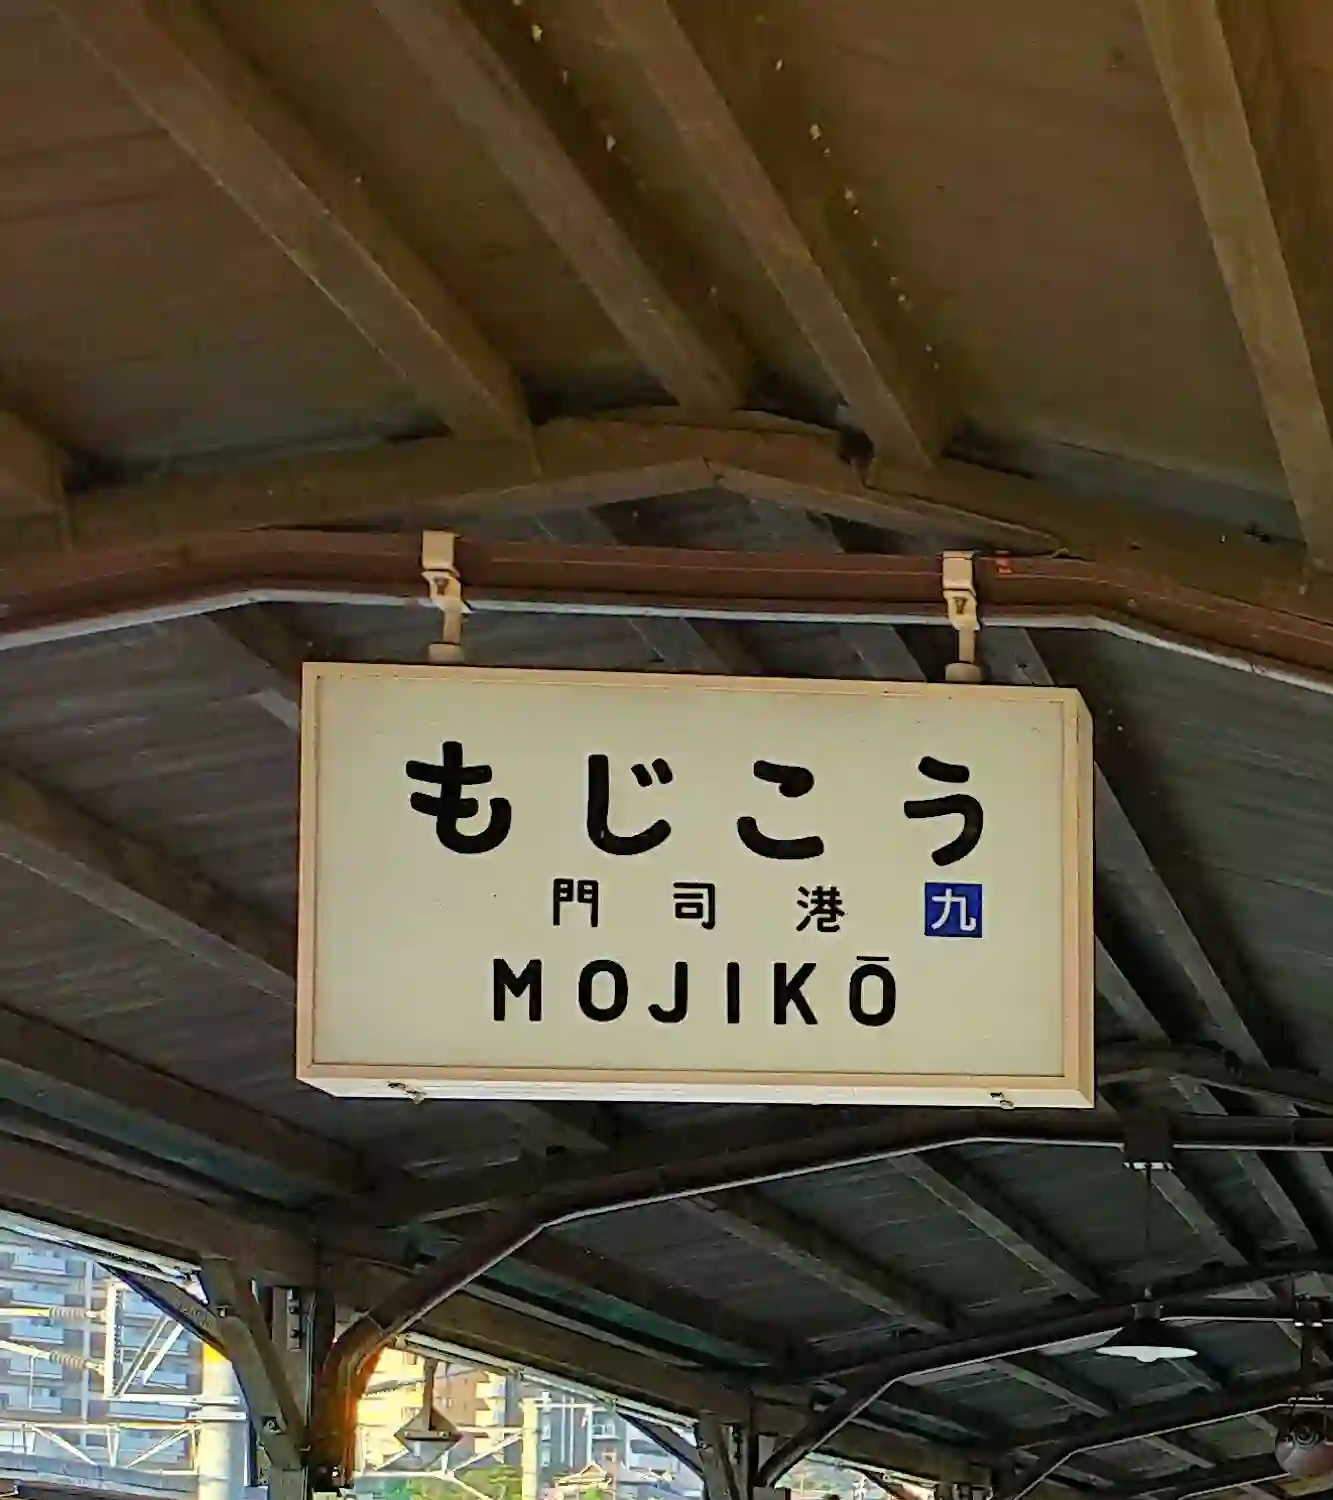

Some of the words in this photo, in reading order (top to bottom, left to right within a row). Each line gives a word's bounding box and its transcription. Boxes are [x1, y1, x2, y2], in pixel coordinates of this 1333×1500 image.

[404, 740, 985, 867] もじこう
[552, 877, 846, 934] 門司港
[930, 887, 977, 932] 九
[492, 955, 897, 1027] MOJIKŌ
